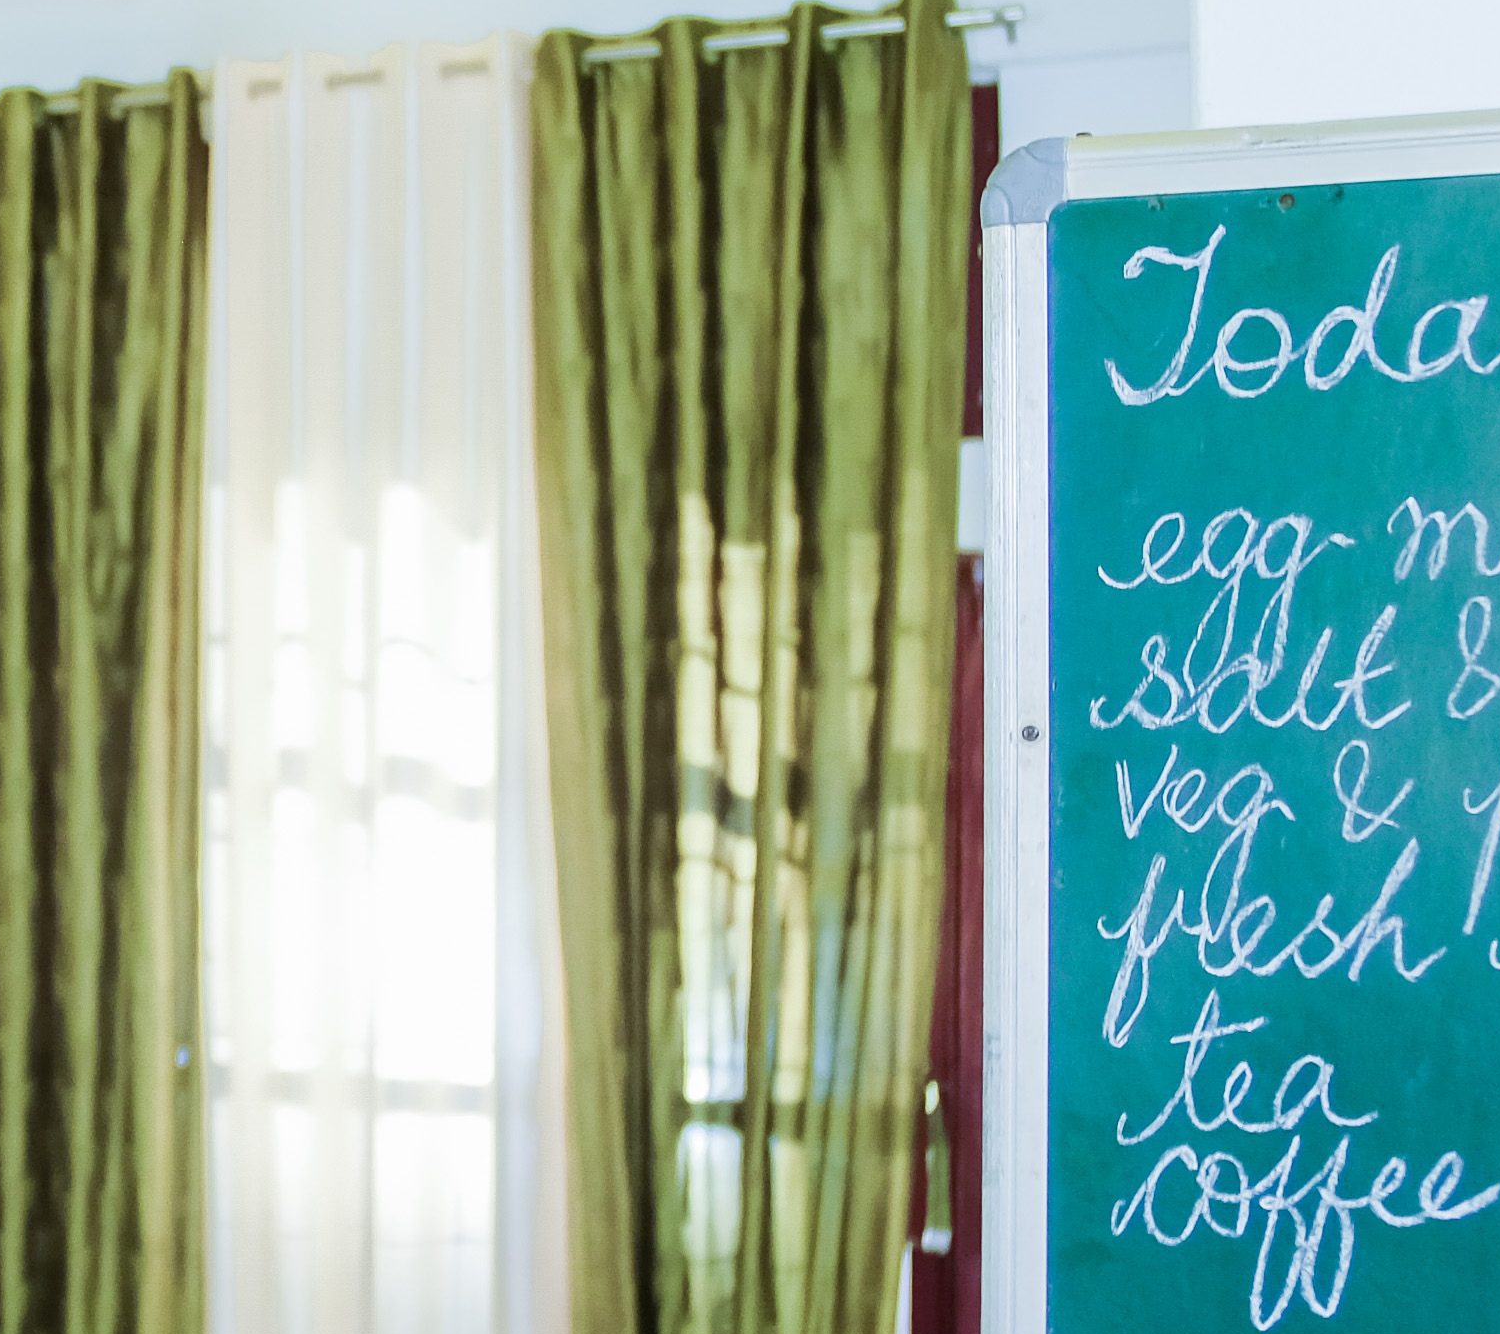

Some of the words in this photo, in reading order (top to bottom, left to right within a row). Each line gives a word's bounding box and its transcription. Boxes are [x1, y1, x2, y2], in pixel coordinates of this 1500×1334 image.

[1089, 603, 1412, 735] salt
[1096, 505, 1356, 689] egg
[1332, 739, 1414, 843] &
[1096, 852, 1448, 1049] fresh
[1116, 987, 1380, 1145] tea
